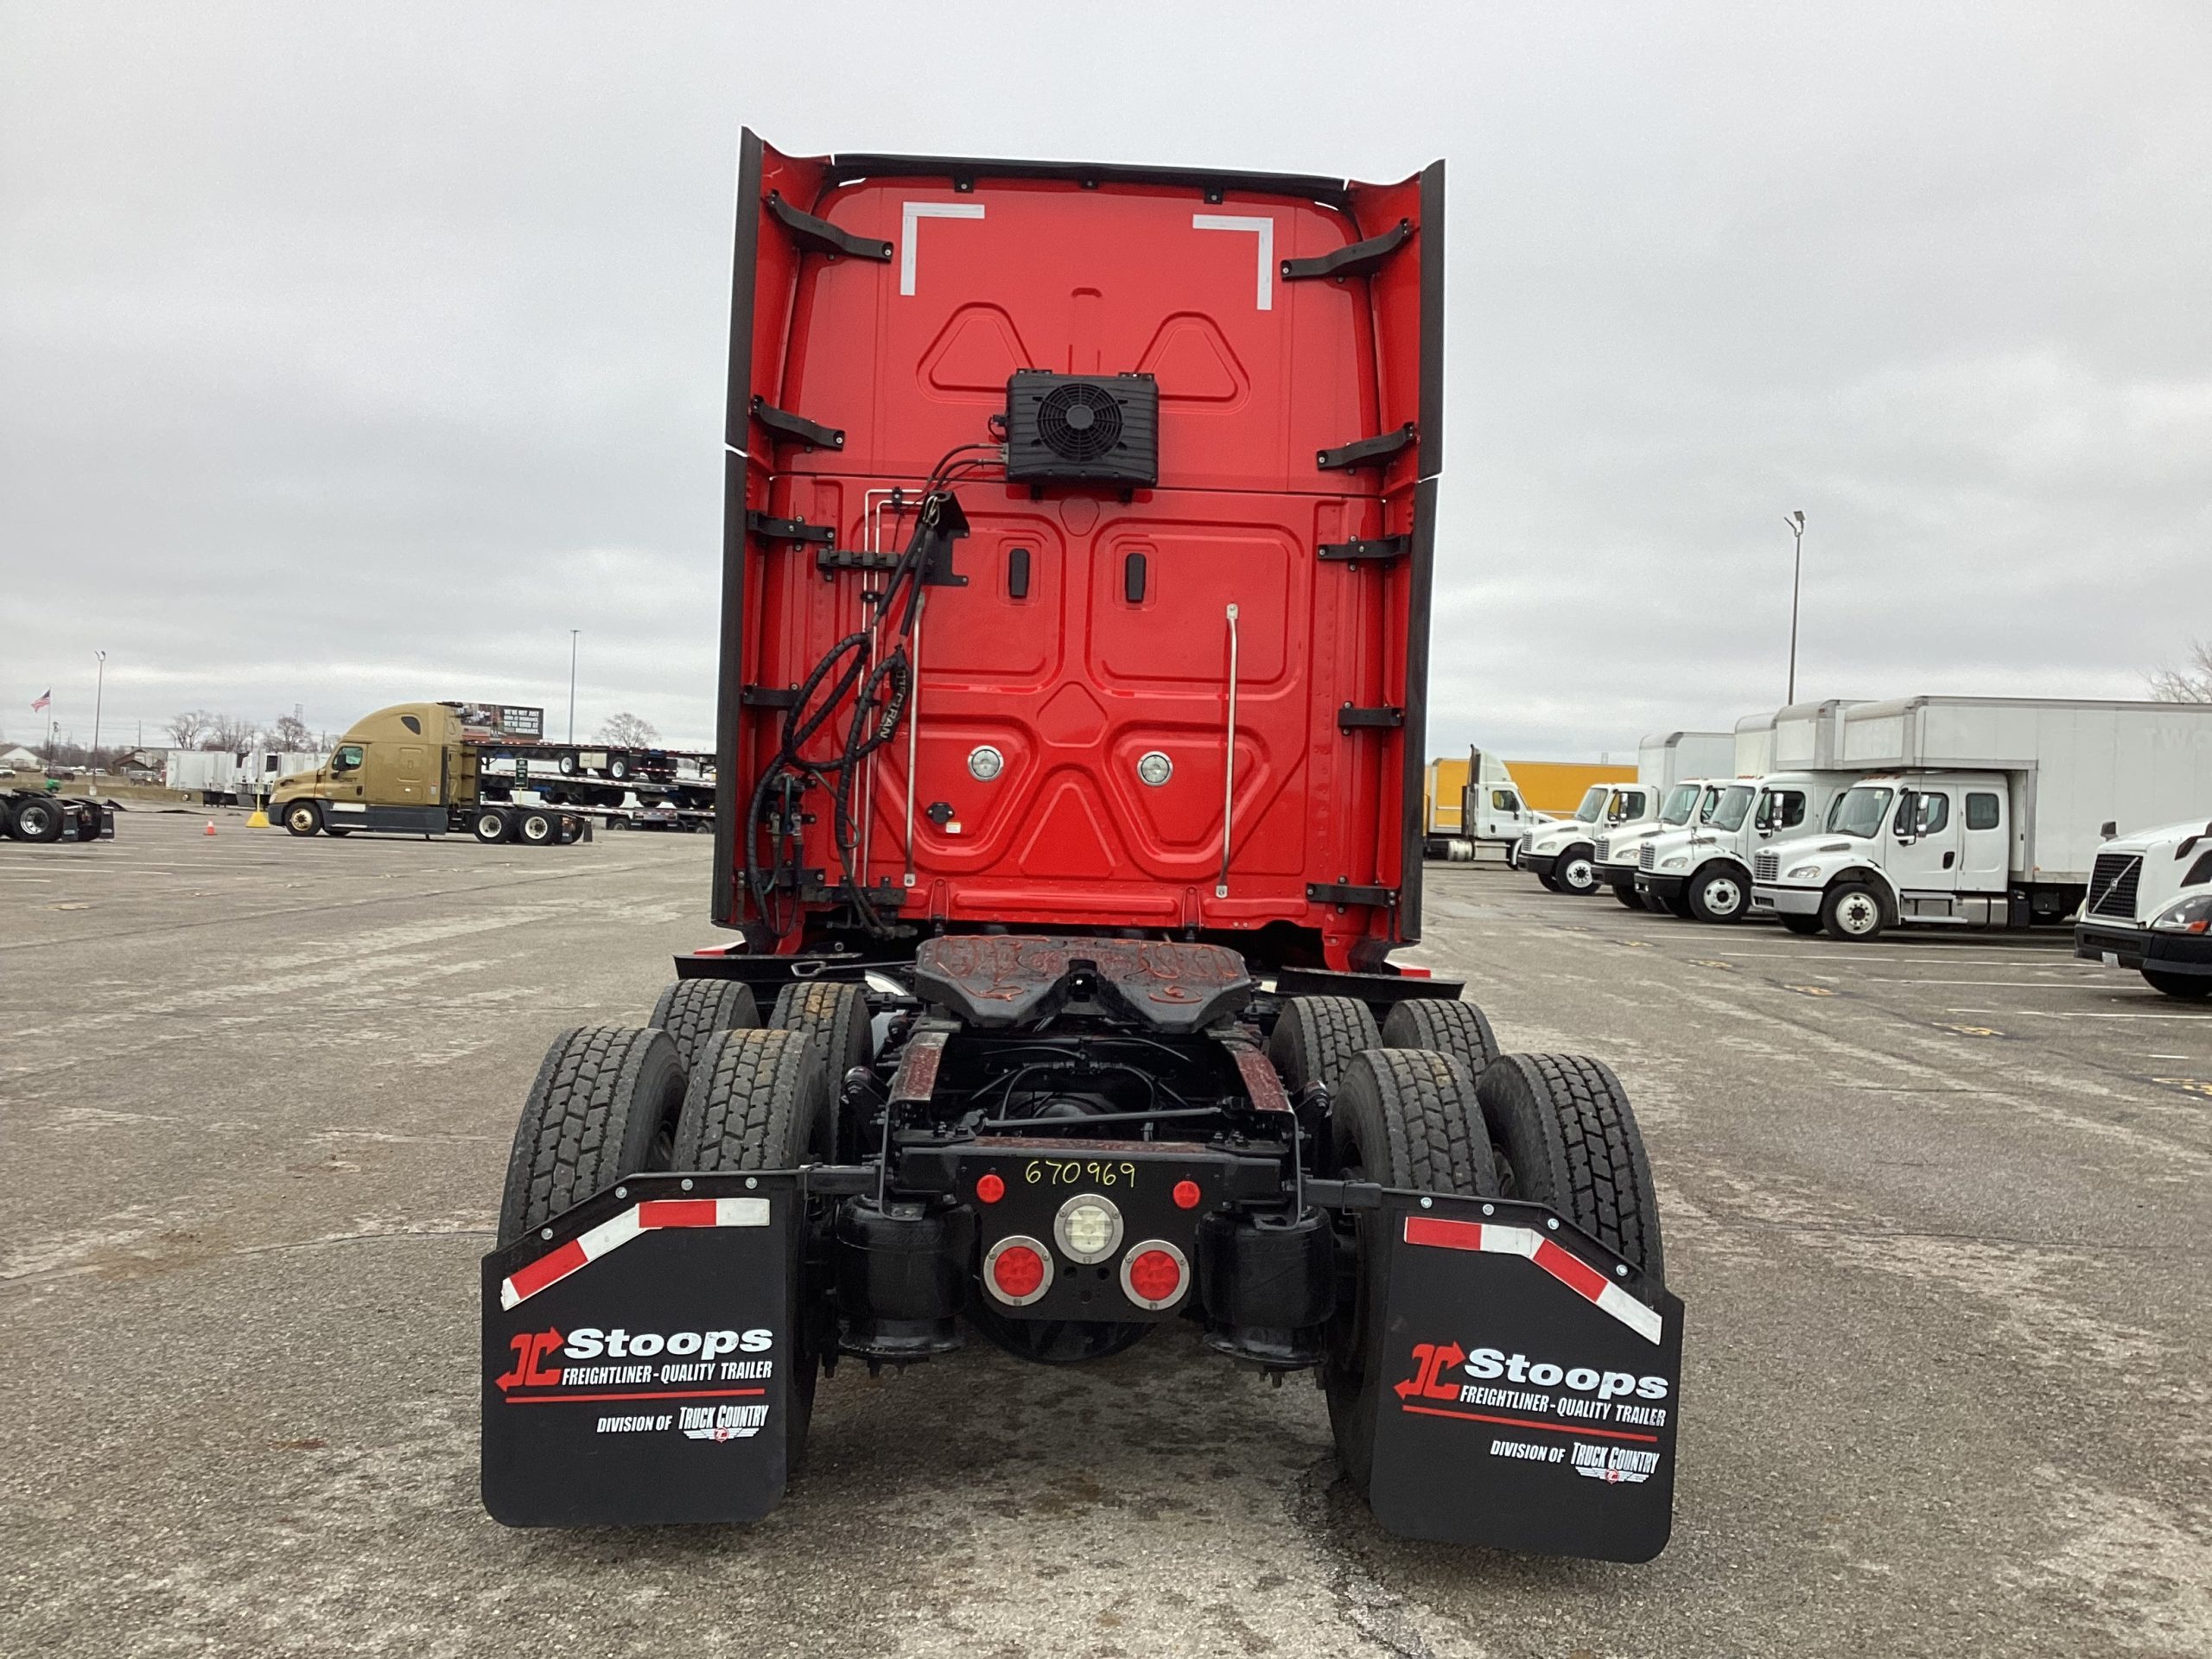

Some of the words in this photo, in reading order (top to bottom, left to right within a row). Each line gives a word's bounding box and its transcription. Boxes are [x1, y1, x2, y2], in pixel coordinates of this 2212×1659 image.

[1026, 1160, 1135, 1188] 670969
[563, 1328, 773, 1360] Stoops
[721, 1361, 772, 1381] TRAILER
[1464, 1348, 1669, 1400] Stoops
[596, 1416, 655, 1433] DIVISION
[656, 1415, 673, 1431] OF
[678, 1406, 716, 1430] TRUCK
[716, 1405, 770, 1429] COUNTRY
[1615, 1404, 1667, 1427] TRAILER
[1490, 1440, 1548, 1462] DIVISION
[1548, 1447, 1566, 1463] OF
[1570, 1442, 1609, 1468] TRUCK
[1608, 1446, 1660, 1474] COUNTRY
